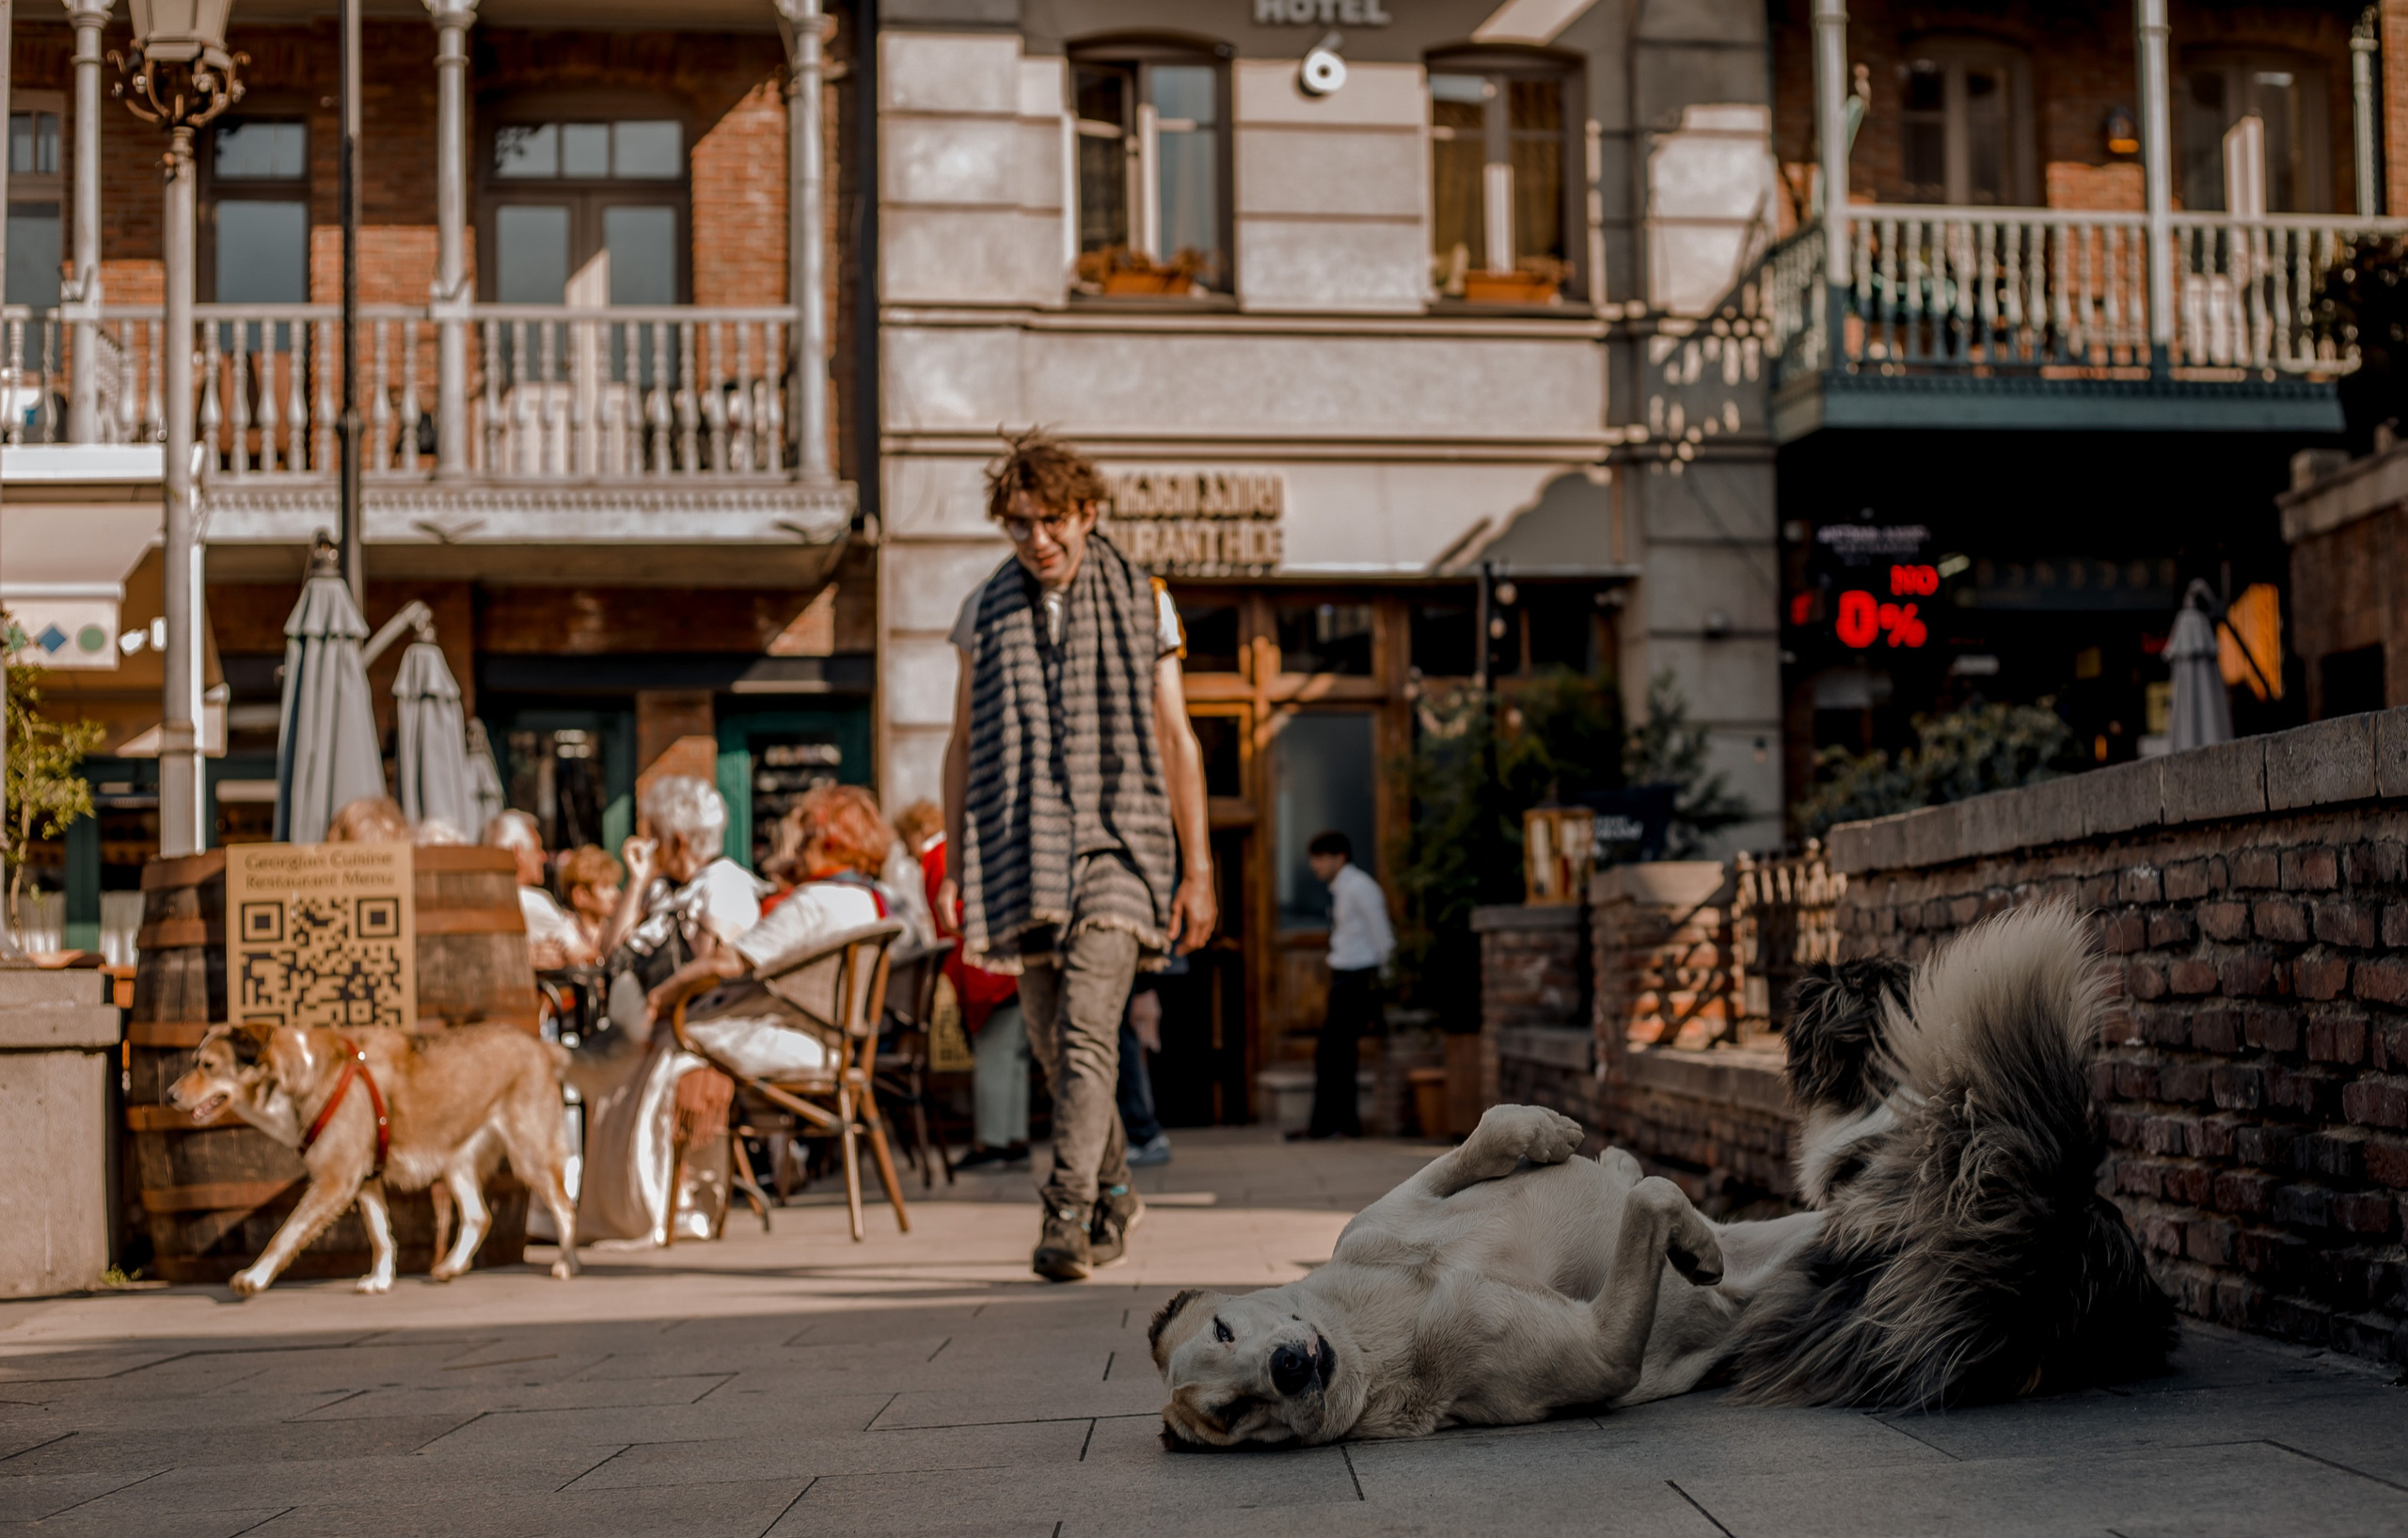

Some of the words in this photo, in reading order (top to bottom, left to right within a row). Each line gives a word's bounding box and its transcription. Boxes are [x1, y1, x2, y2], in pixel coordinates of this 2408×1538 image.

[1255, 0, 1391, 24] HOTEL
[1835, 590, 1927, 648] 0%
[245, 852, 326, 872] Georgian
[330, 849, 393, 867] Cuisine
[246, 873, 336, 890] Restaurant
[341, 870, 394, 886] Menu
